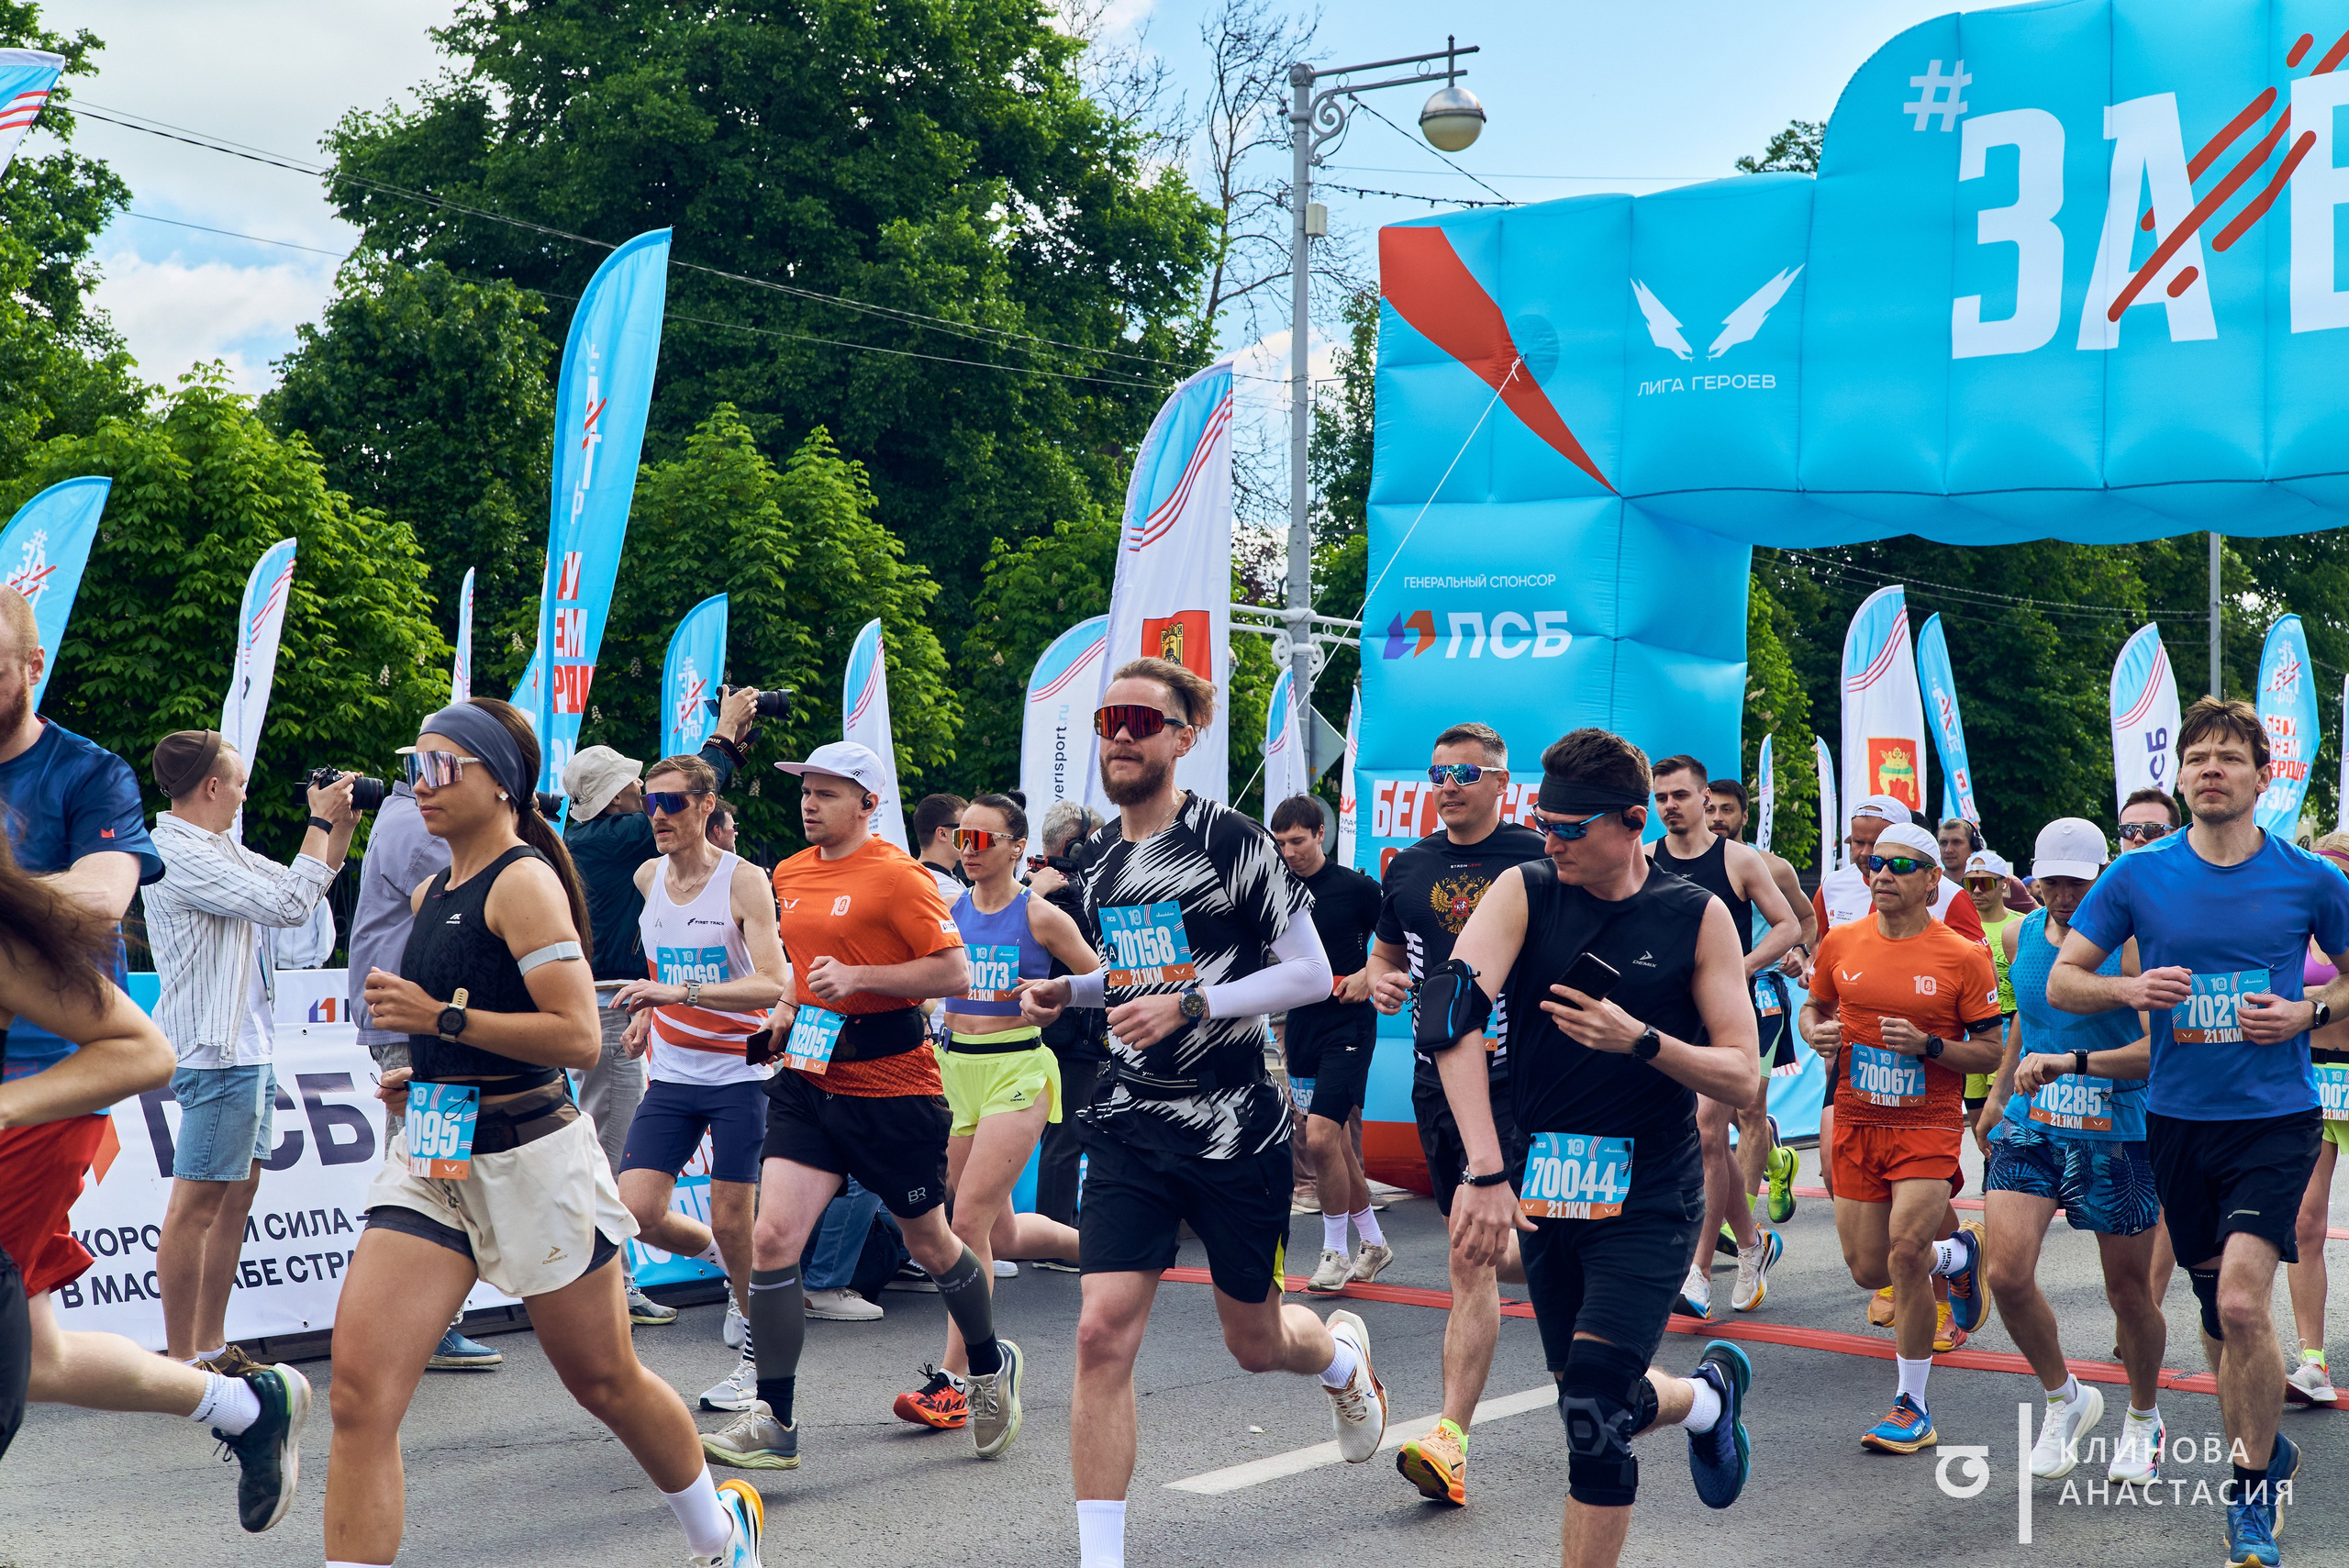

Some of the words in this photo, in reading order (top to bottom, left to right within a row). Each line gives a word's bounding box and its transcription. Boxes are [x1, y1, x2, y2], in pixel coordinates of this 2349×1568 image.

[1637, 377, 1685, 396] ЛИГА
[1692, 373, 1776, 391] ГЕРОЕВ
[1404, 574, 1486, 588] ГЕНЕРАЛЬНЫЙ
[1489, 573, 1556, 588] СПОНСОР
[1445, 610, 1573, 659] ПСБ
[2145, 728, 2167, 787] СБ
[1372, 780, 1441, 838] БЕГ
[1108, 946, 1118, 959] A
[1111, 926, 1176, 967] 70158
[967, 960, 1009, 989] 0073
[1130, 966, 1164, 986] 21.1KM
[1632, 960, 1657, 968] DEMIX
[967, 988, 995, 1002] 21.1KM
[2204, 1028, 2243, 1044] 21.1KM
[1858, 1062, 1916, 1095] 70067
[1870, 1092, 1900, 1107] 21.1KM
[2319, 1082, 2349, 1109] 007
[407, 1109, 462, 1156] 095
[2050, 1112, 2083, 1129] 21.1KM
[1531, 1157, 1618, 1201] 70044
[1546, 1200, 1592, 1219] 21.1KM
[72, 1224, 161, 1260] КОРО
[263, 1207, 354, 1242] СИЛА
[542, 1253, 568, 1265] DEMIX
[61, 1281, 84, 1309] В
[285, 1251, 355, 1284] СТР
